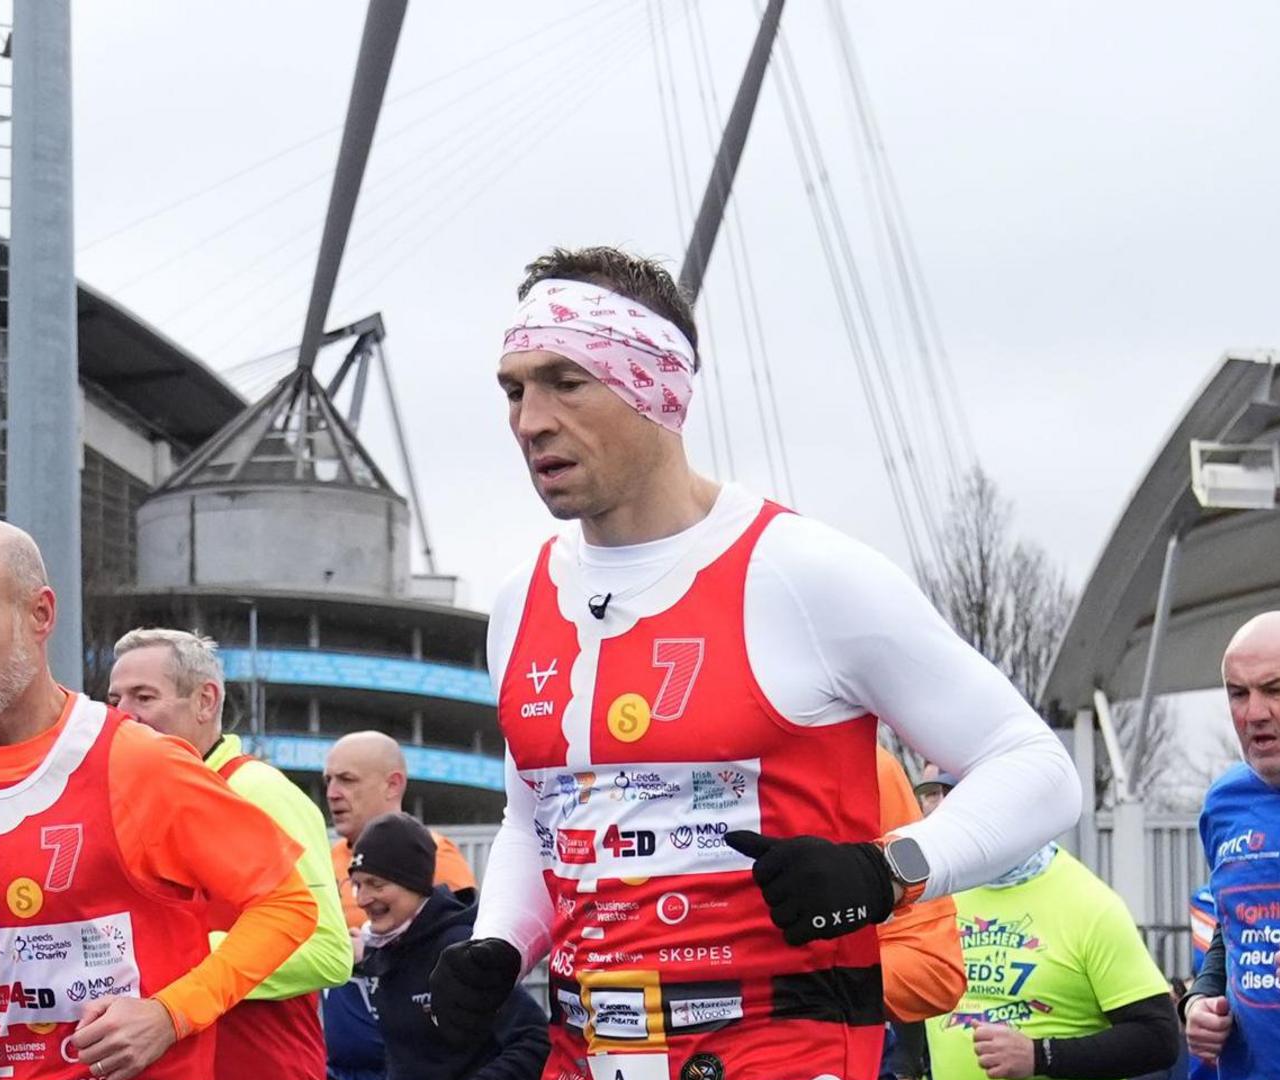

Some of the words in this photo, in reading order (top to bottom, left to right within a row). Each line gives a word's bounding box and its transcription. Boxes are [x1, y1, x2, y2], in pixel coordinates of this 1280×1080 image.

[651, 636, 706, 723] 7
[520, 700, 554, 718] OXEN
[617, 703, 639, 734] S
[631, 771, 661, 783] Leeds
[696, 822, 728, 834] MND
[602, 824, 656, 858] 4ED
[40, 822, 84, 892] 7
[15, 885, 33, 911] S
[595, 900, 639, 911] business
[812, 905, 867, 929] OXEN
[26, 933, 54, 943] Leeds
[31, 940, 72, 951] Hospitals
[960, 930, 1021, 950] INISHER
[35, 950, 68, 961] Charity
[658, 945, 733, 962] SKOPES
[88, 975, 115, 989] MND
[964, 963, 1005, 983] EDS
[1008, 961, 1038, 996] 7
[11, 981, 56, 1009] 4ED
[967, 985, 1005, 996] ATHON
[692, 1008, 732, 1022] Woods
[987, 1000, 1030, 1022] 2024
[5, 1042, 47, 1053] business
